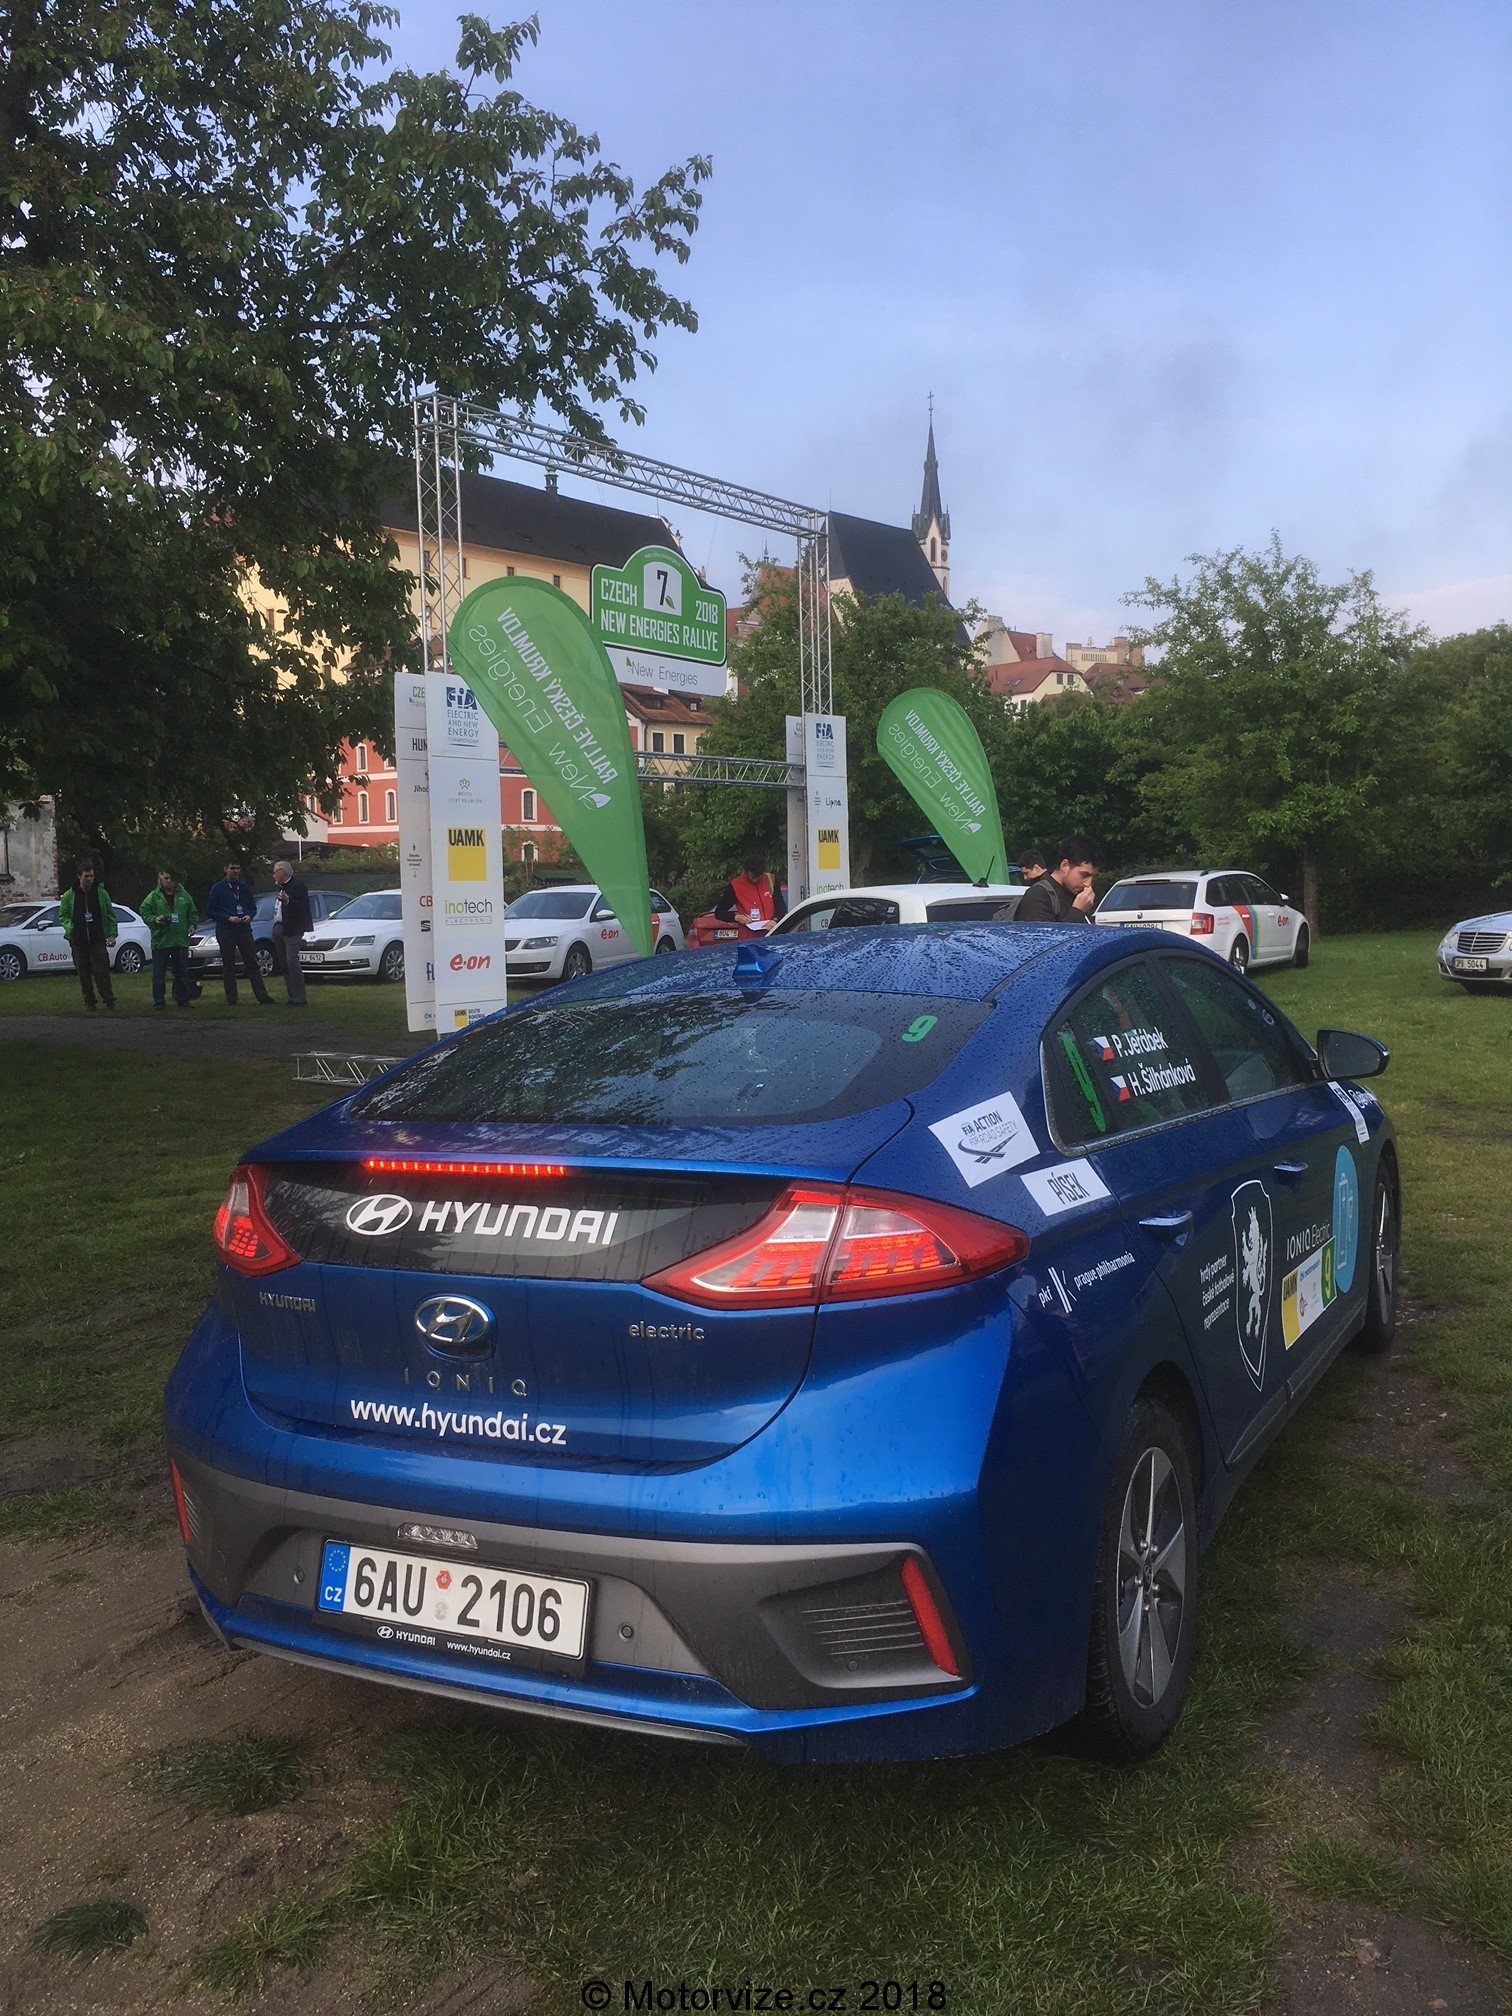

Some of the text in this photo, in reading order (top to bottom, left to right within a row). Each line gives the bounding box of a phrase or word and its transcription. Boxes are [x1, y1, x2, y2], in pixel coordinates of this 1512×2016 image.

[601, 577, 638, 607] CZECH
[657, 570, 668, 606] 7
[695, 600, 718, 625] 2018
[601, 608, 718, 653] NEW ENERGIES RALLYE
[631, 661, 698, 687] New Energies
[447, 710, 479, 721] ELECTRIC
[447, 719, 462, 727] AND
[448, 727, 479, 738] ENERGY
[448, 828, 485, 847] UAMK
[818, 829, 840, 843] UAMK
[445, 898, 493, 915] inotech
[37, 952, 68, 961] CB Auto
[1467, 960, 1484, 969] 5044
[901, 1015, 938, 1042] 9
[973, 1110, 1003, 1132] ACTION
[978, 1129, 998, 1144] ROAD
[1046, 1171, 1091, 1205] PÍSEK
[417, 1199, 620, 1247] HYUNDAI
[1073, 1250, 1136, 1291] prague philharmonia
[1324, 1247, 1332, 1299] 9
[258, 1291, 317, 1313] HYUNDAI
[1038, 1285, 1053, 1308] pkf
[628, 1321, 706, 1342] electric
[350, 1399, 568, 1446] www.hyundai.cz
[324, 1586, 342, 1603] CZ
[353, 1556, 563, 1642] 6AU 2106
[396, 1630, 437, 1647] HYUNDAI
[446, 1640, 512, 1661] www.hyundai.cz
